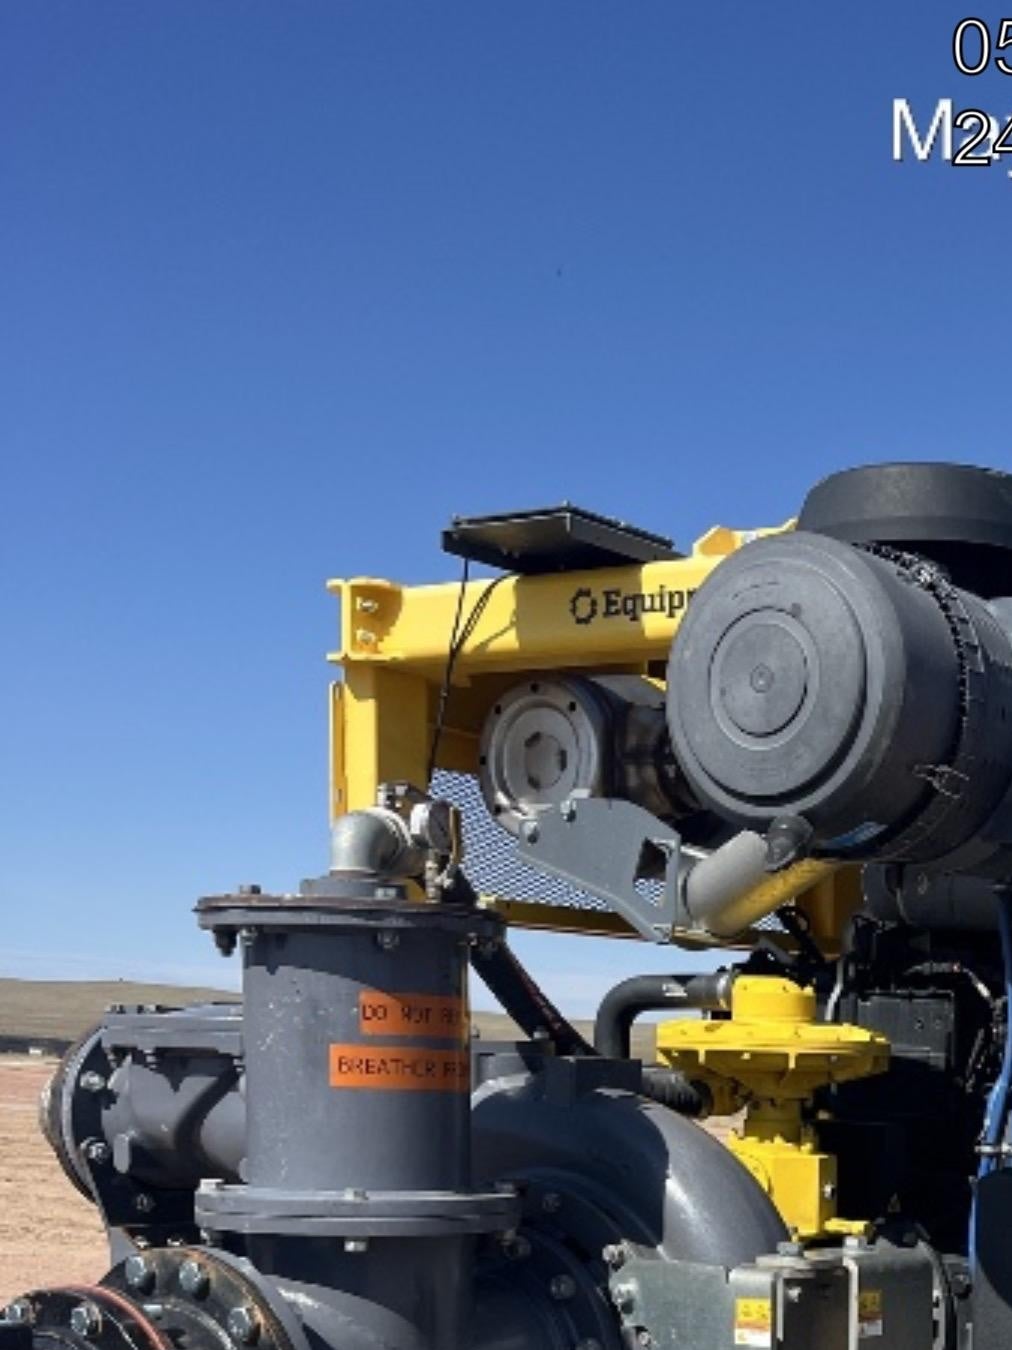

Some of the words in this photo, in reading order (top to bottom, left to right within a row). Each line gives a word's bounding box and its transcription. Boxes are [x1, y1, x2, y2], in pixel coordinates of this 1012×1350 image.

[602, 584, 698, 621] Equip
[362, 1004, 388, 1021] DO
[401, 1005, 433, 1024] NOT
[338, 1055, 436, 1078] BREATHER
